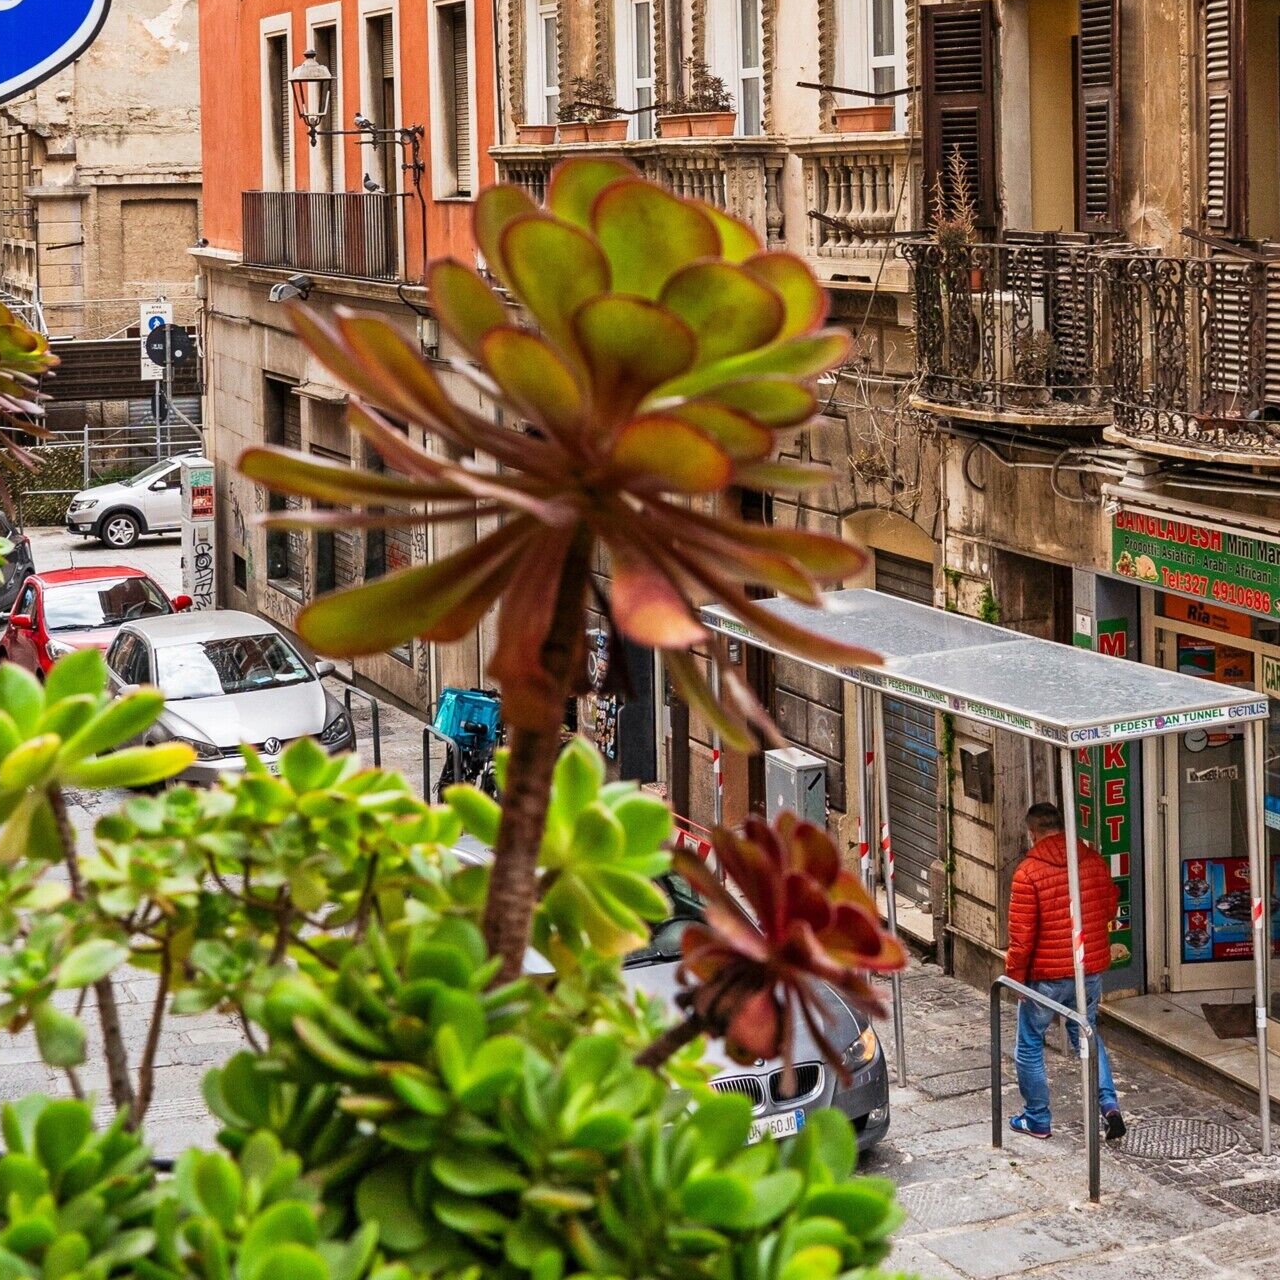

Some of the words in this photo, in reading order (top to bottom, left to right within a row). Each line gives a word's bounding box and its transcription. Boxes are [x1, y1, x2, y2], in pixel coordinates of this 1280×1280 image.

[1116, 511, 1222, 552] BANGLADESH
[1227, 534, 1254, 559] Mini
[1124, 536, 1160, 555] Prodotti:
[1161, 545, 1195, 565] Asiatici
[1203, 556, 1227, 573] Arabi
[1235, 563, 1271, 585] Africani
[1212, 580, 1270, 614] 4910686
[888, 679, 923, 697] PEDESTRIAN
[923, 689, 947, 704] TUNNEL
[967, 701, 1006, 721] PEDESTRIAN
[1006, 713, 1033, 730] TUNNEL
[1113, 715, 1180, 733] PEDESTAN
[1182, 708, 1225, 723] TUNNEL
[1228, 702, 1267, 719] GENIUS
[1099, 631, 1126, 843] MKET
